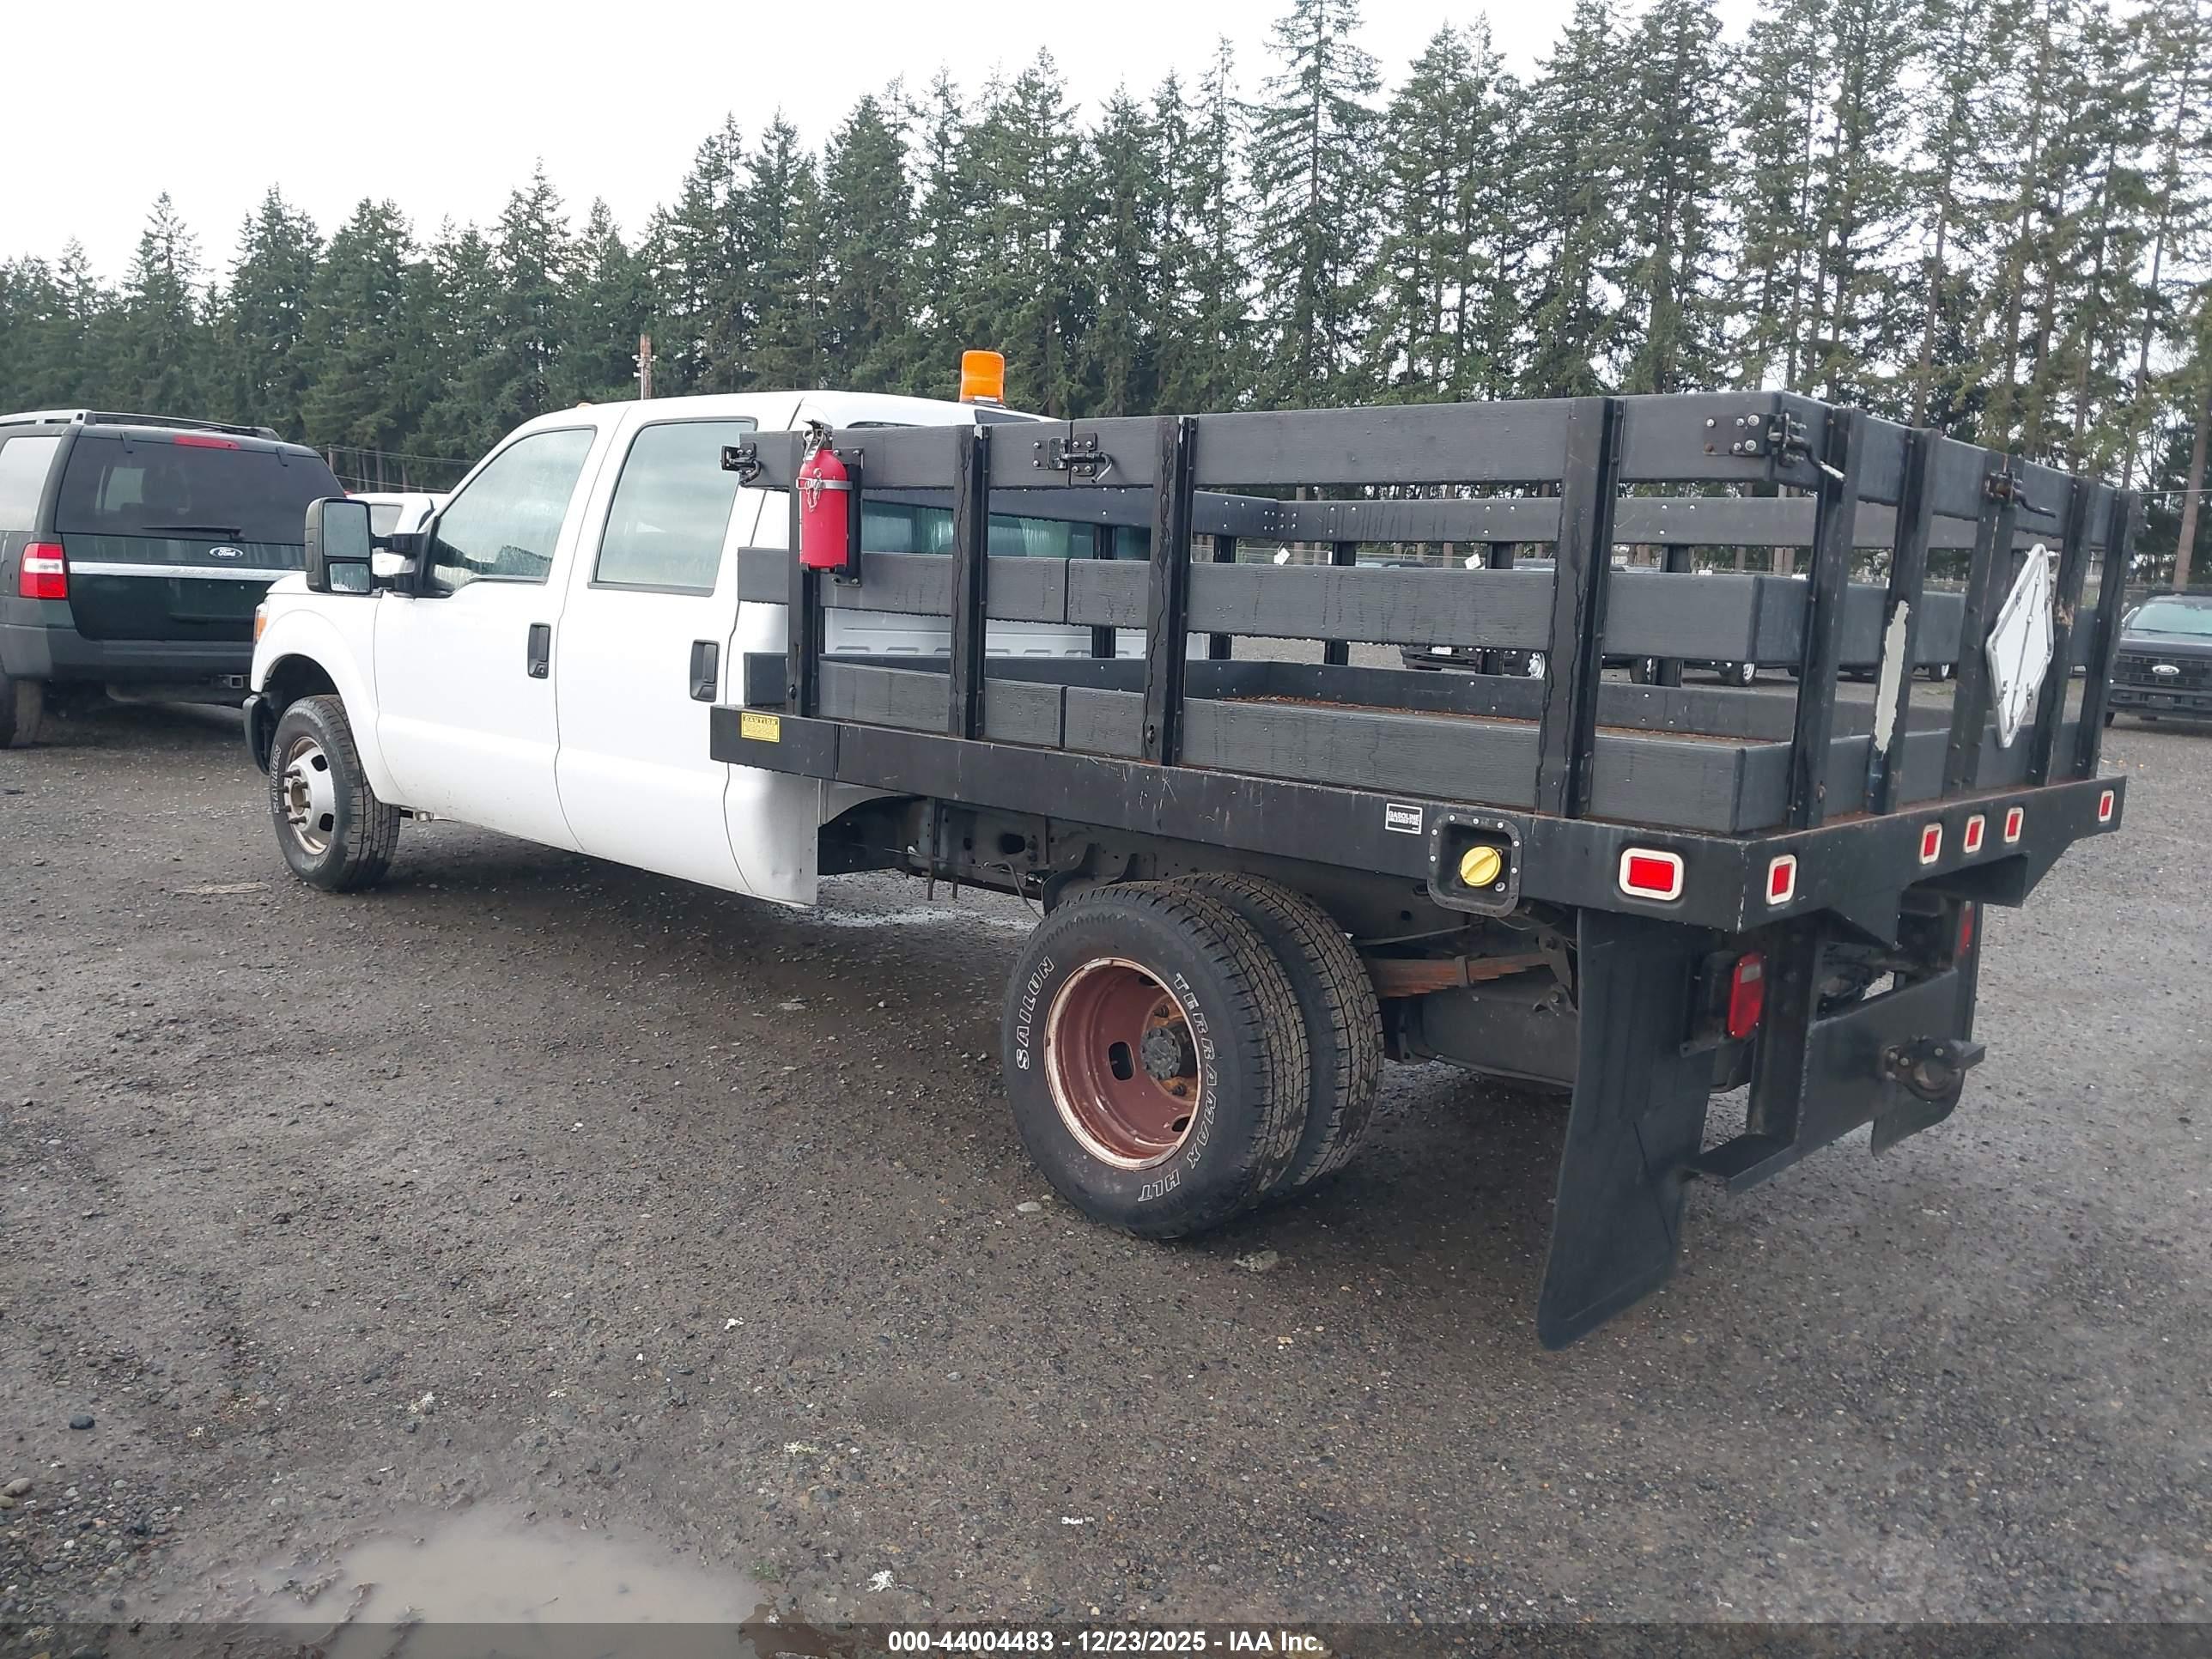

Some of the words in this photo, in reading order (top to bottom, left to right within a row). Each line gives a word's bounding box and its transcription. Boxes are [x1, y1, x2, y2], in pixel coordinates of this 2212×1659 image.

[1389, 811, 1420, 822] GASOLINE
[1016, 956, 1055, 1071] SAILUN
[1173, 972, 1218, 1170] TERRAMAX
[1138, 1169, 1181, 1201] HLT
